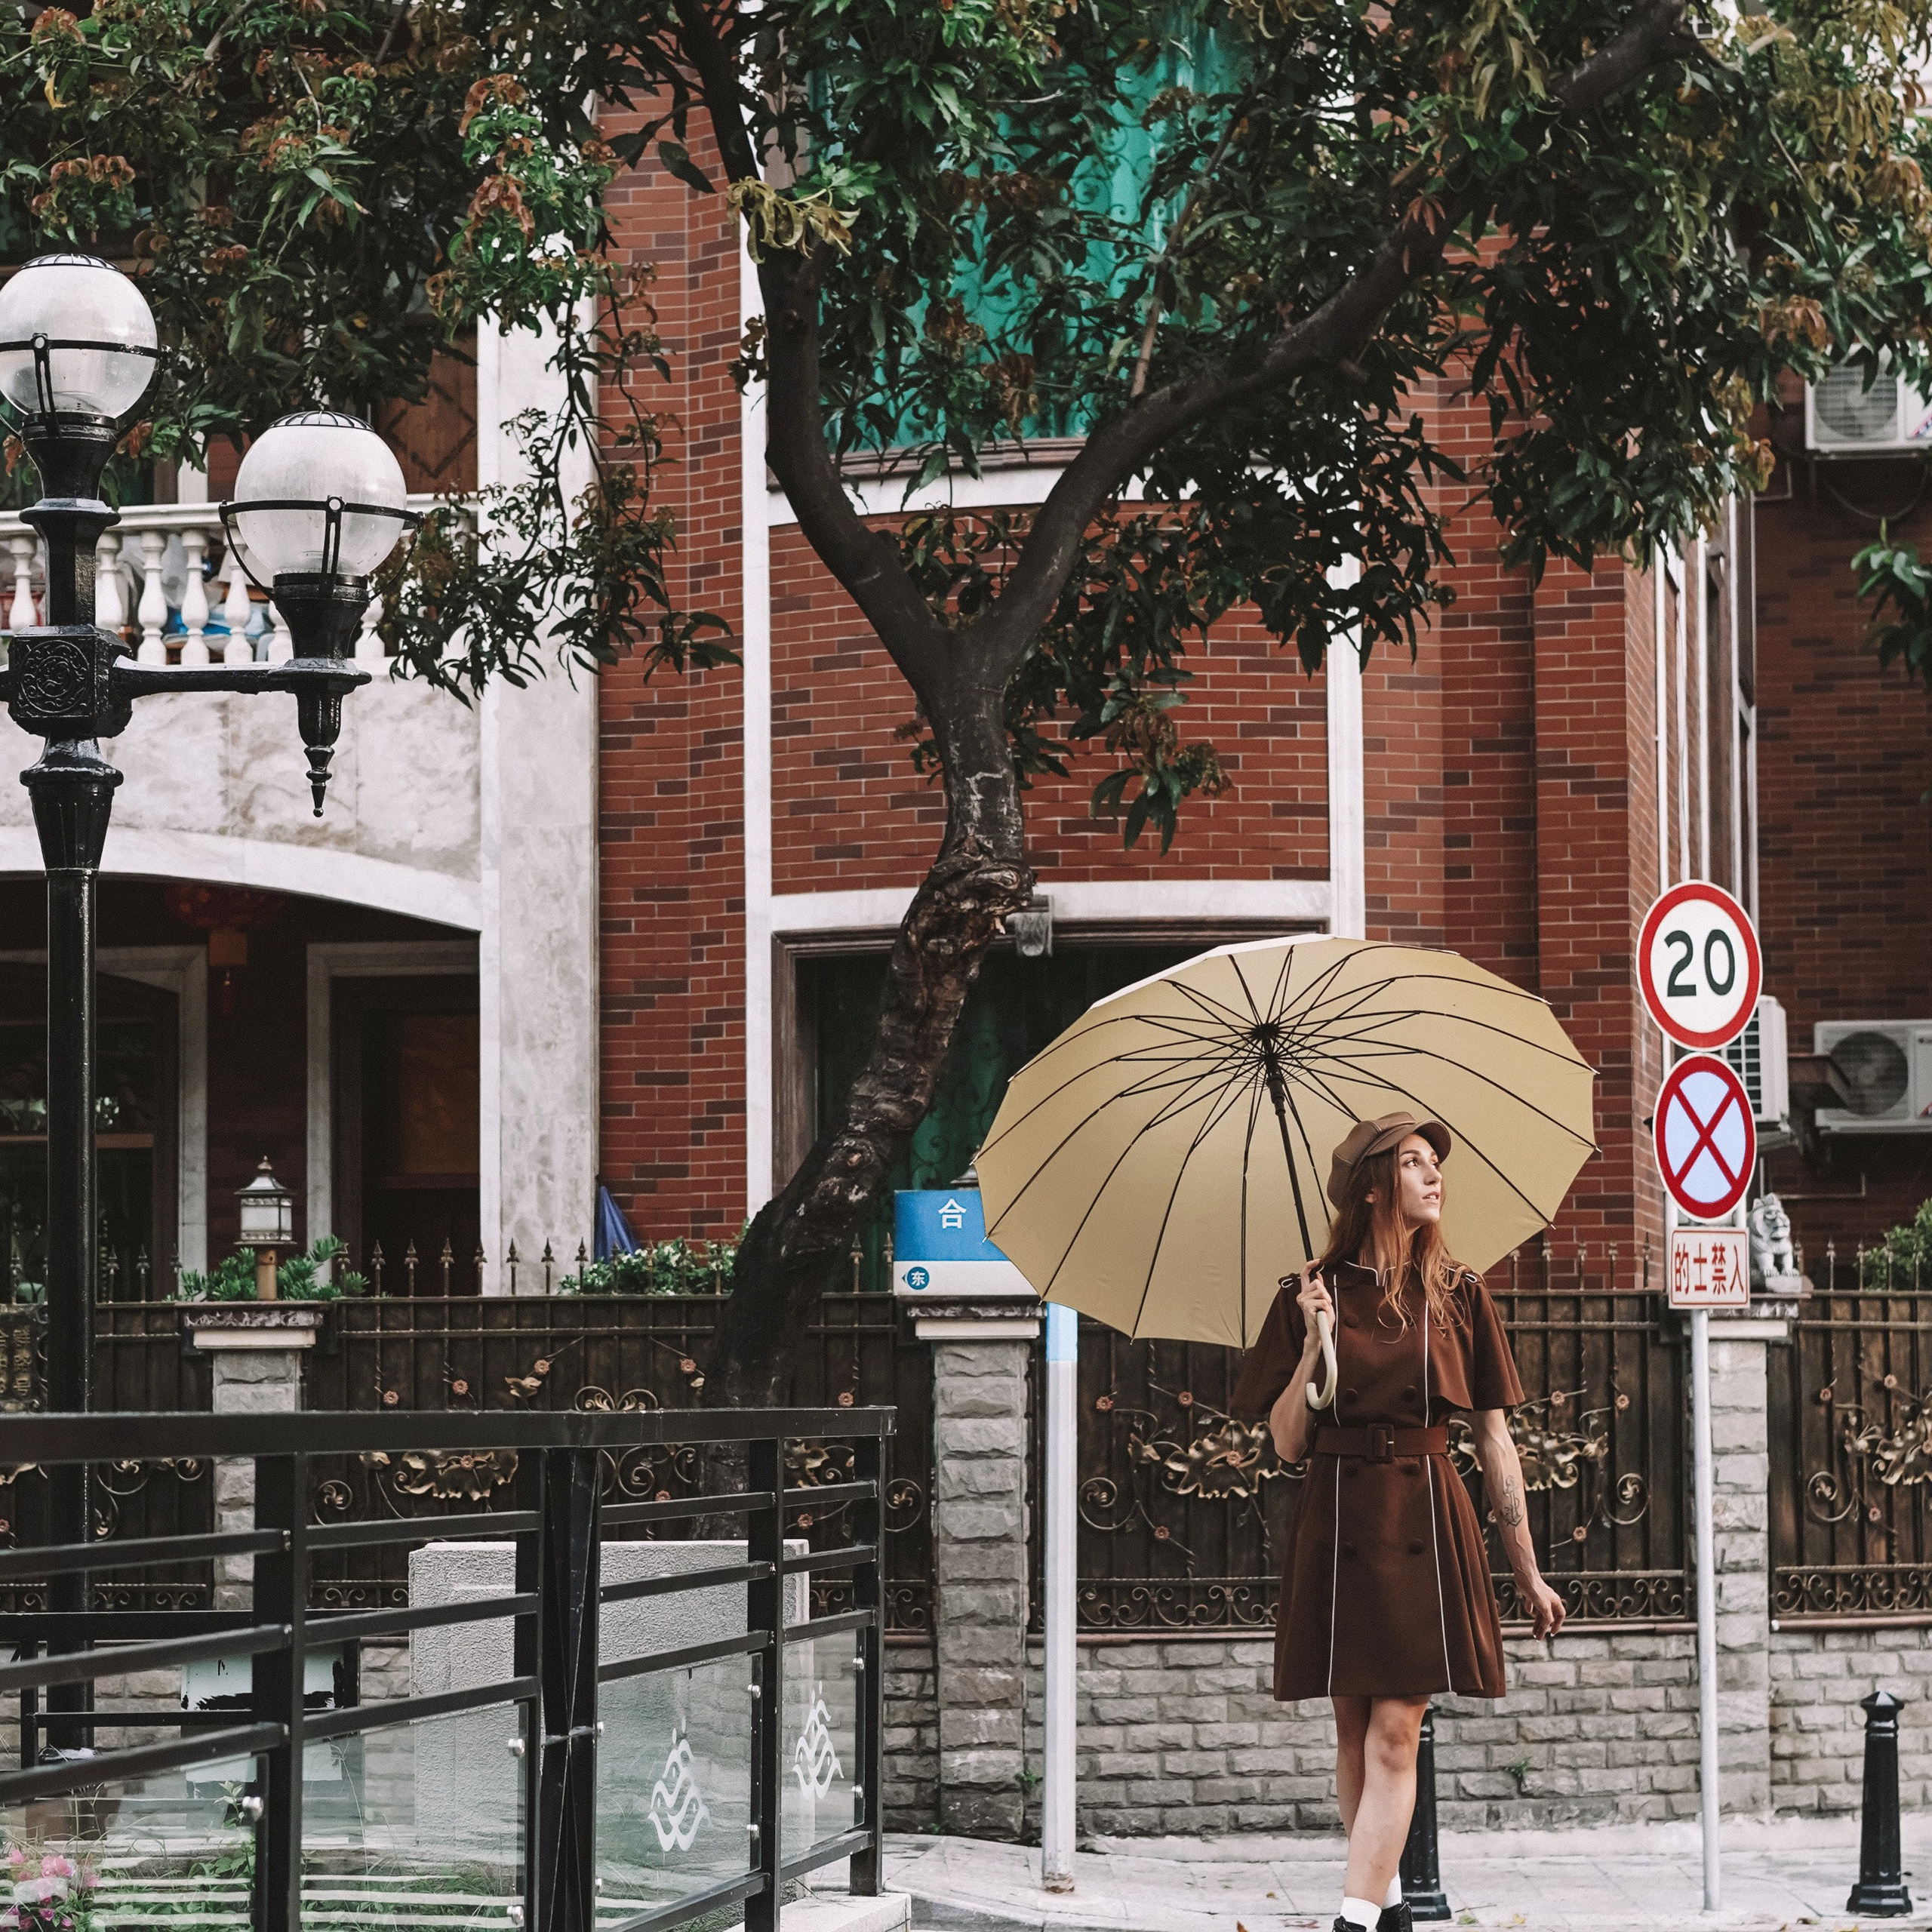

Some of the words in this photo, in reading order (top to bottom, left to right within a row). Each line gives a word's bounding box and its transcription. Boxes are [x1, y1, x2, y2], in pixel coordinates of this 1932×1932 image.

[1663, 928, 1736, 997] 20
[938, 1198, 967, 1229] 合
[911, 1271, 925, 1286] 东
[1675, 1242, 1744, 1295] 的士禁入
